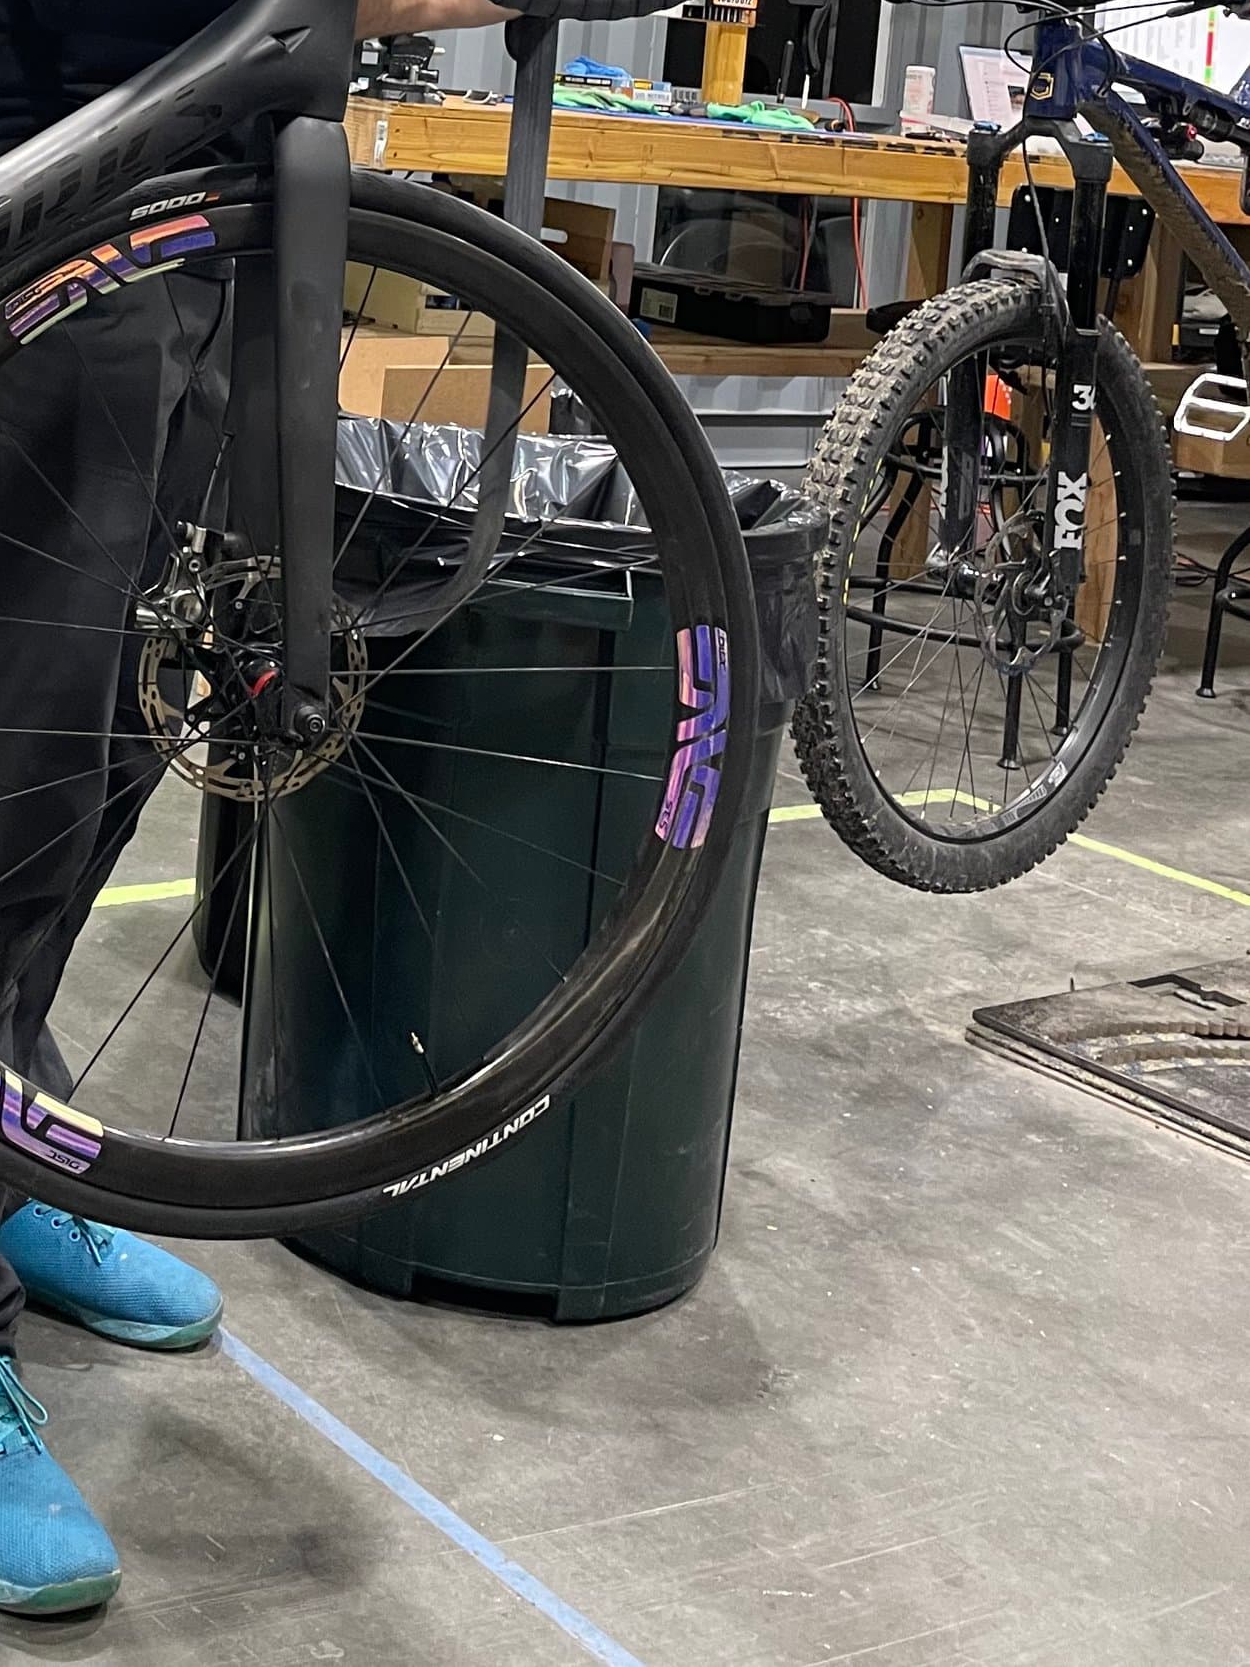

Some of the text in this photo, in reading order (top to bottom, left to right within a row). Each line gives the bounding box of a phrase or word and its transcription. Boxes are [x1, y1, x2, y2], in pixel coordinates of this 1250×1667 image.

[130, 191, 206, 222] 5000
[1071, 383, 1097, 411] 3
[1053, 471, 1089, 551] FOX
[45, 1149, 82, 1171] DISC
[382, 1093, 551, 1198] CONTINENTAL
